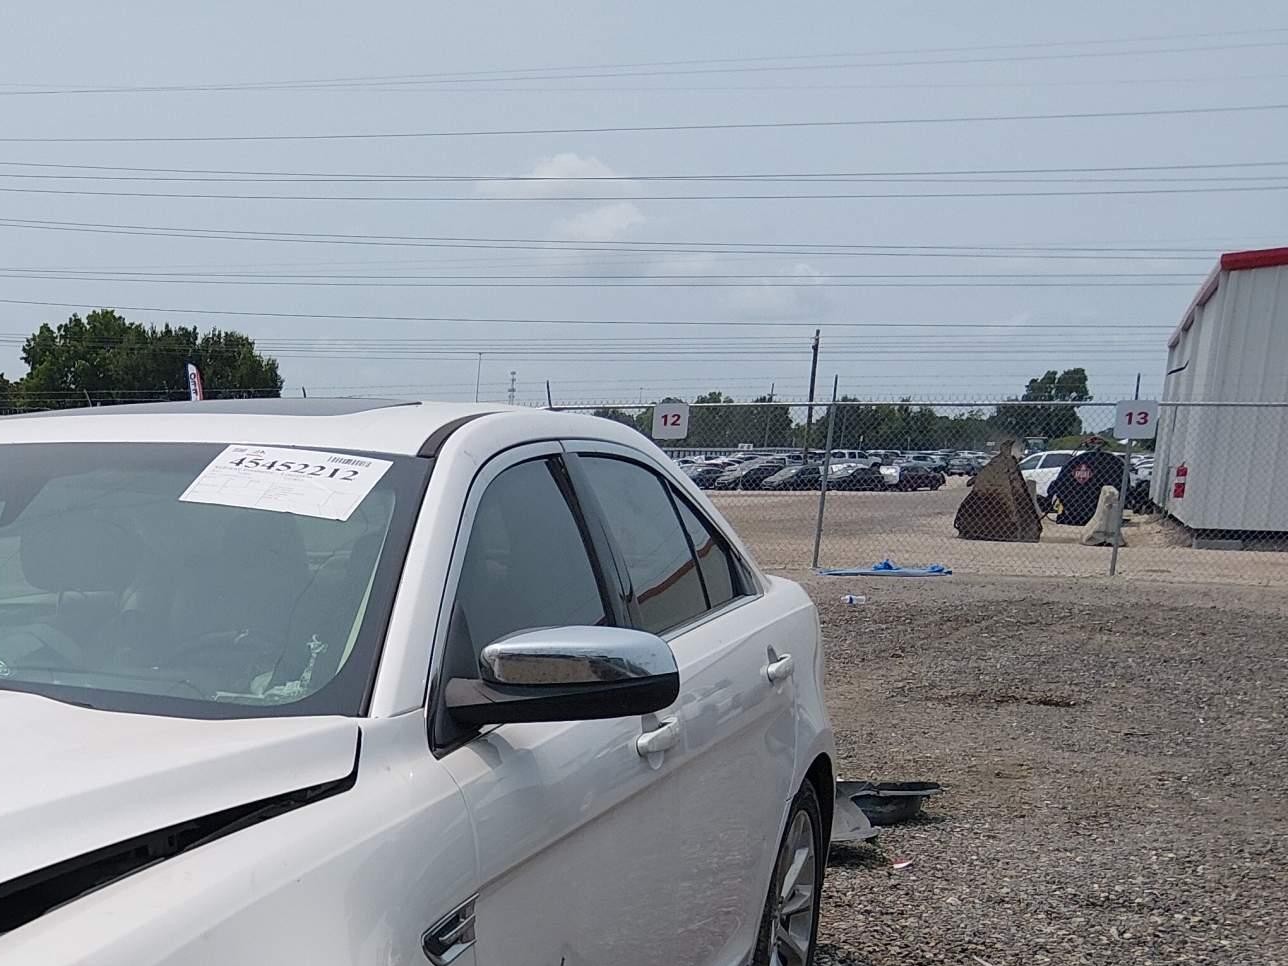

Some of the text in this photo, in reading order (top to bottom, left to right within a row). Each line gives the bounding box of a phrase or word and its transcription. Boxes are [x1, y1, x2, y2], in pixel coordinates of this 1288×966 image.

[661, 413, 681, 427] 12
[1125, 411, 1149, 426] 13
[229, 456, 360, 482] 45452212
